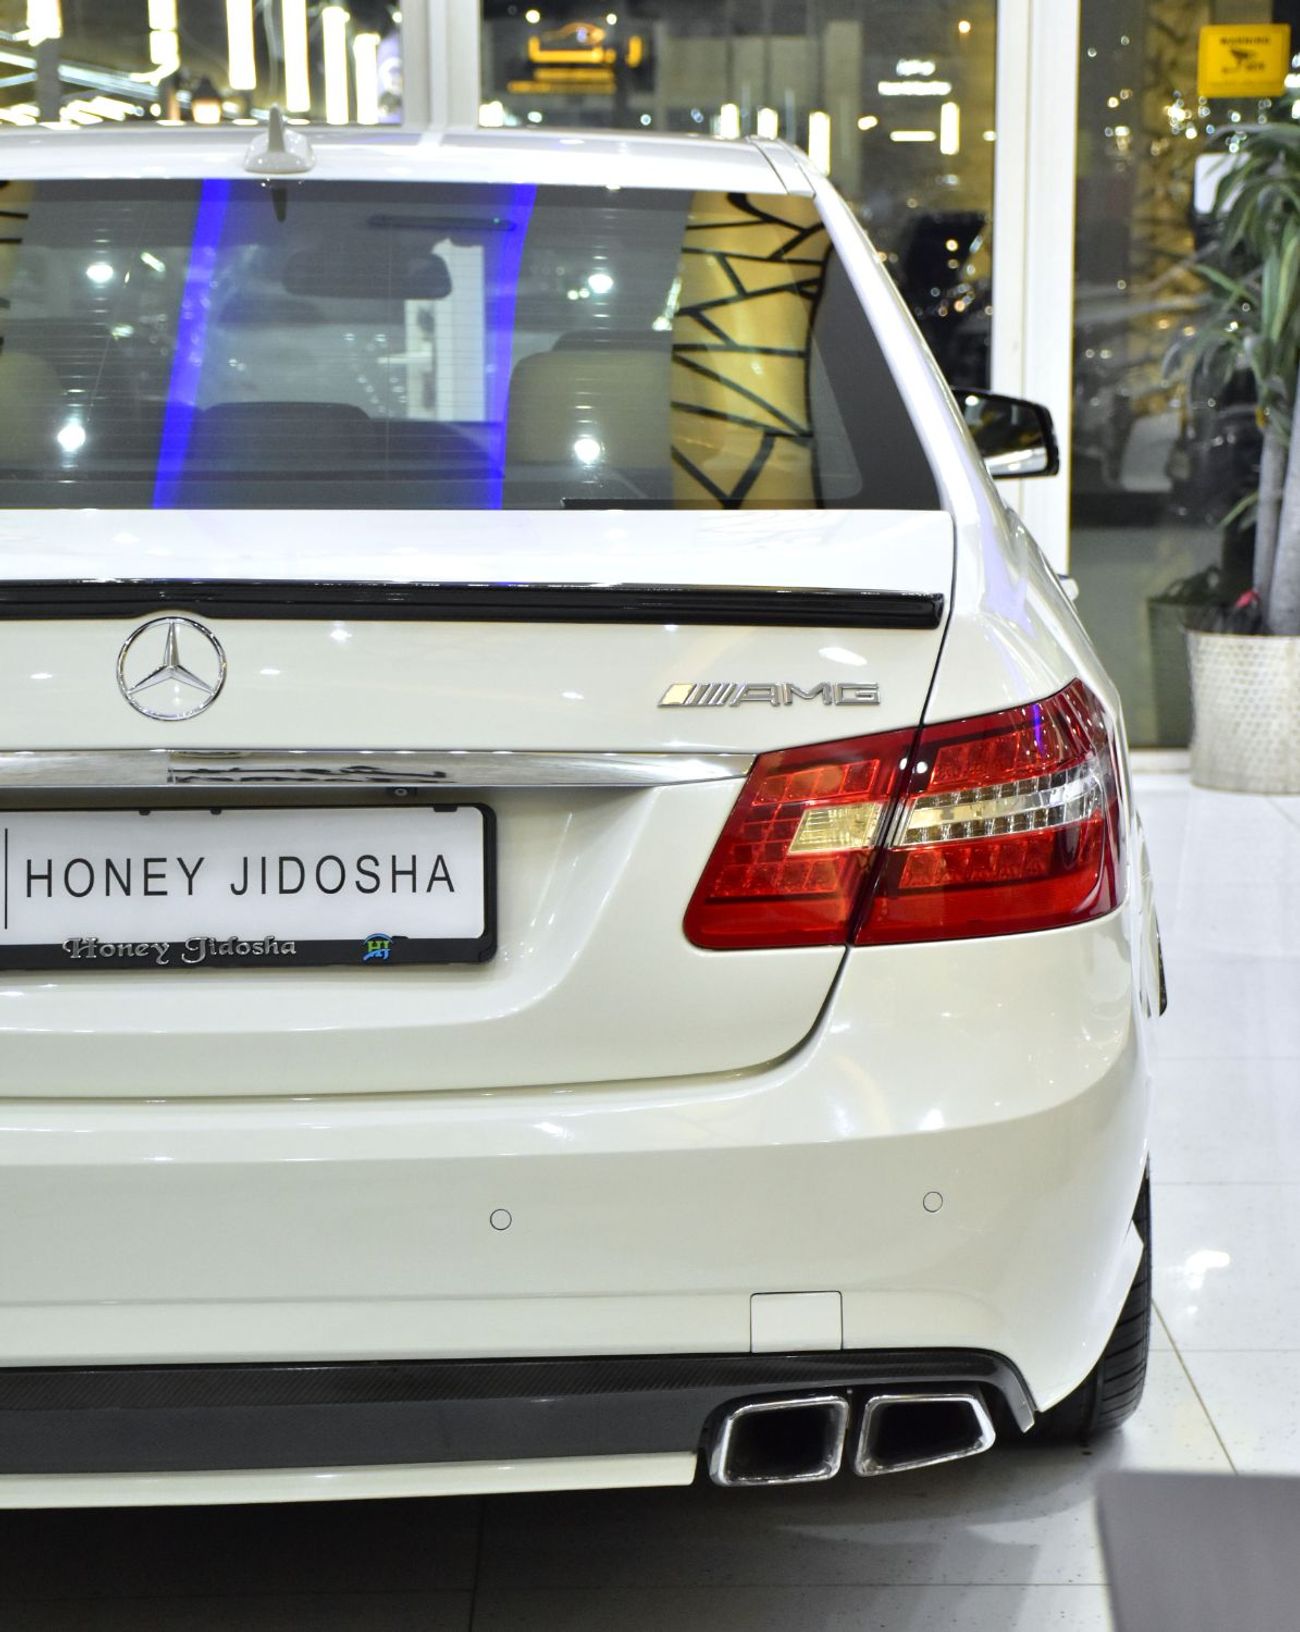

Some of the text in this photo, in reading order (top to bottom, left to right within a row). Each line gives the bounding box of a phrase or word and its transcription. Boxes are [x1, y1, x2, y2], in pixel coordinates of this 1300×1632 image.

[25, 853, 456, 899] HONEY JIDOSHA
[62, 934, 298, 965] Honey Jidosha
